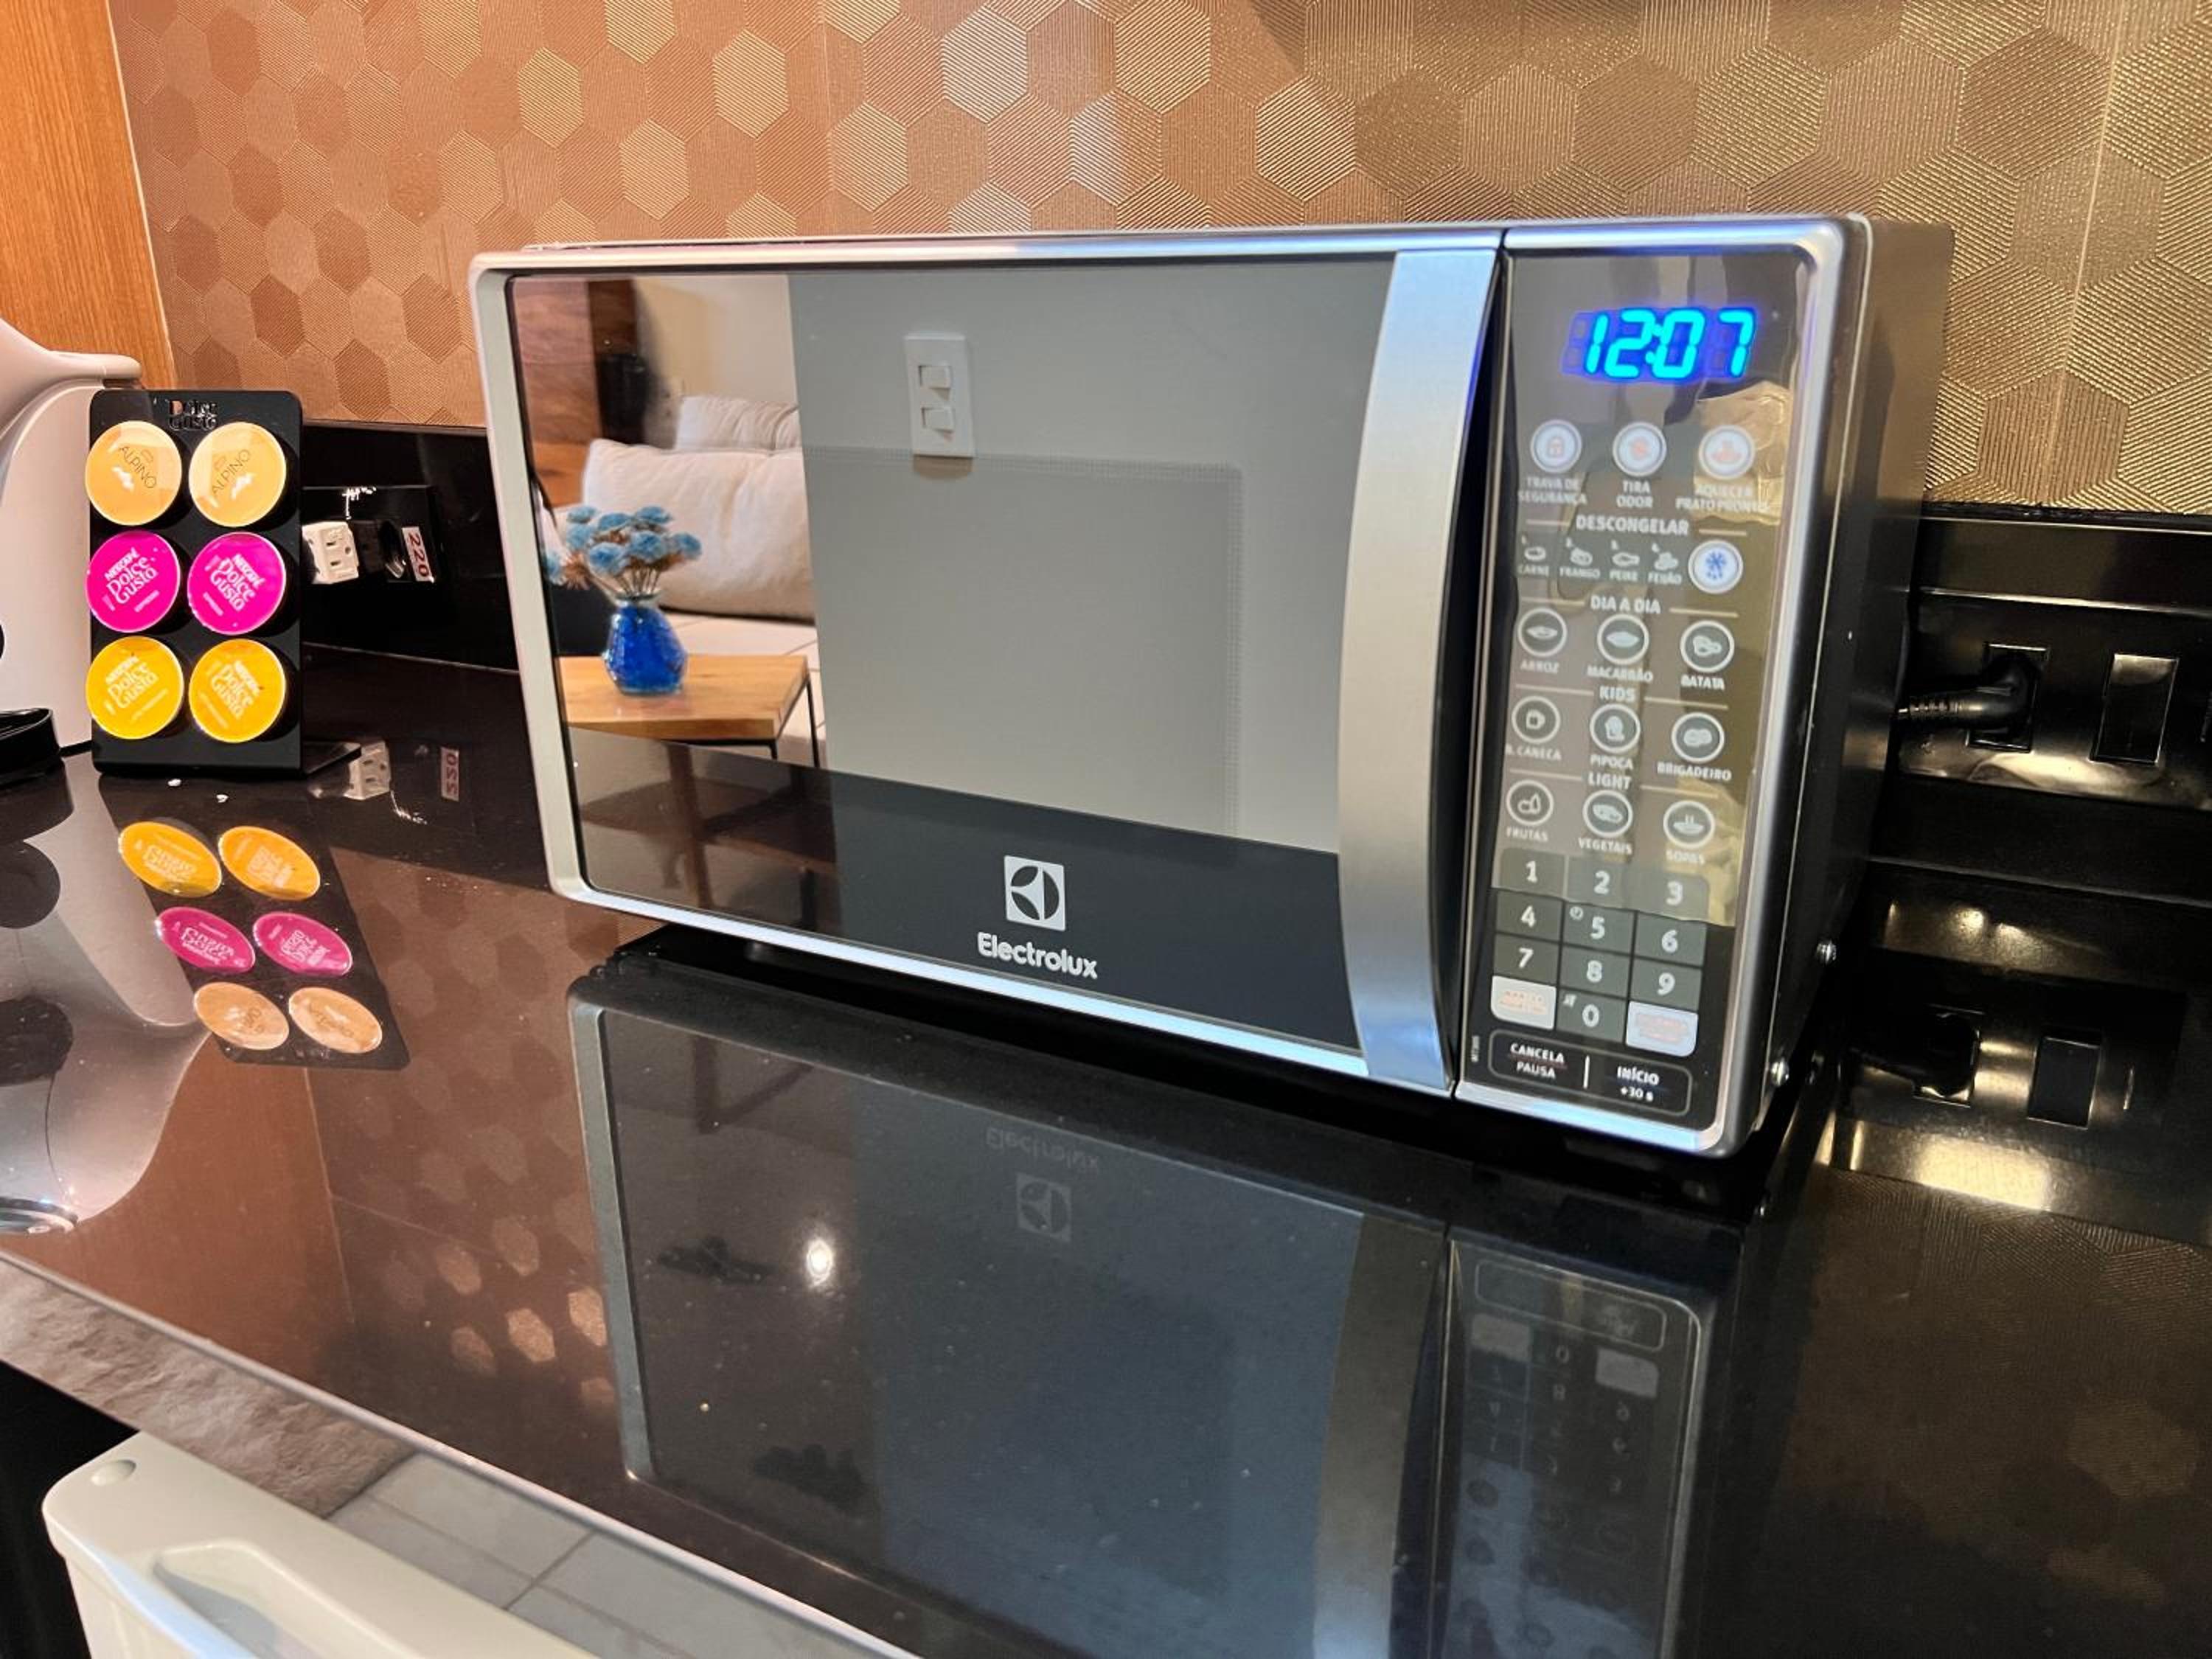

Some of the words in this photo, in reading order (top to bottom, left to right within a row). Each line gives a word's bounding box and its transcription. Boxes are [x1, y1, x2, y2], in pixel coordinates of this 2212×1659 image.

[1585, 307, 1756, 379] 12:07
[119, 445, 157, 490] ALPINO
[212, 448, 251, 495] ALPINO
[1622, 479, 1650, 493] TIRA
[1615, 495, 1654, 509] ODOR
[1575, 514, 1689, 536] DESCONGELAR
[408, 532, 430, 577] 220
[105, 556, 149, 597] Dolce
[116, 566, 159, 605] Gusto
[1590, 595, 1617, 612] DIA
[1619, 597, 1631, 612] A
[1633, 599, 1662, 614] DIA
[1680, 674, 1725, 691] BATATA
[1599, 685, 1636, 703] KIDS
[1516, 745, 1562, 761] CANECA
[1590, 754, 1634, 771] PIPOCA
[1587, 771, 1632, 790] LIGHT
[1656, 761, 1732, 782] BRIGADEIRO
[1506, 827, 1548, 843] FRUTAS
[1577, 837, 1633, 855] VEGETAIS
[1525, 860, 1538, 883] 1
[1593, 870, 1611, 896] 2
[1665, 880, 1684, 906] 3
[1520, 905, 1537, 928] 4
[1590, 915, 1606, 940] 5
[1660, 929, 1679, 954] 6
[977, 931, 1098, 980] Electrolux
[1518, 947, 1534, 969] 7
[1585, 959, 1603, 984] 8
[1657, 972, 1676, 995] 9
[1582, 1004, 1600, 1028] 0
[1509, 1042, 1565, 1063] CANCELA
[1516, 1061, 1557, 1079] PAUSA
[1616, 1065, 1660, 1086] INÍCIO
[1620, 1085, 1644, 1099] +30
